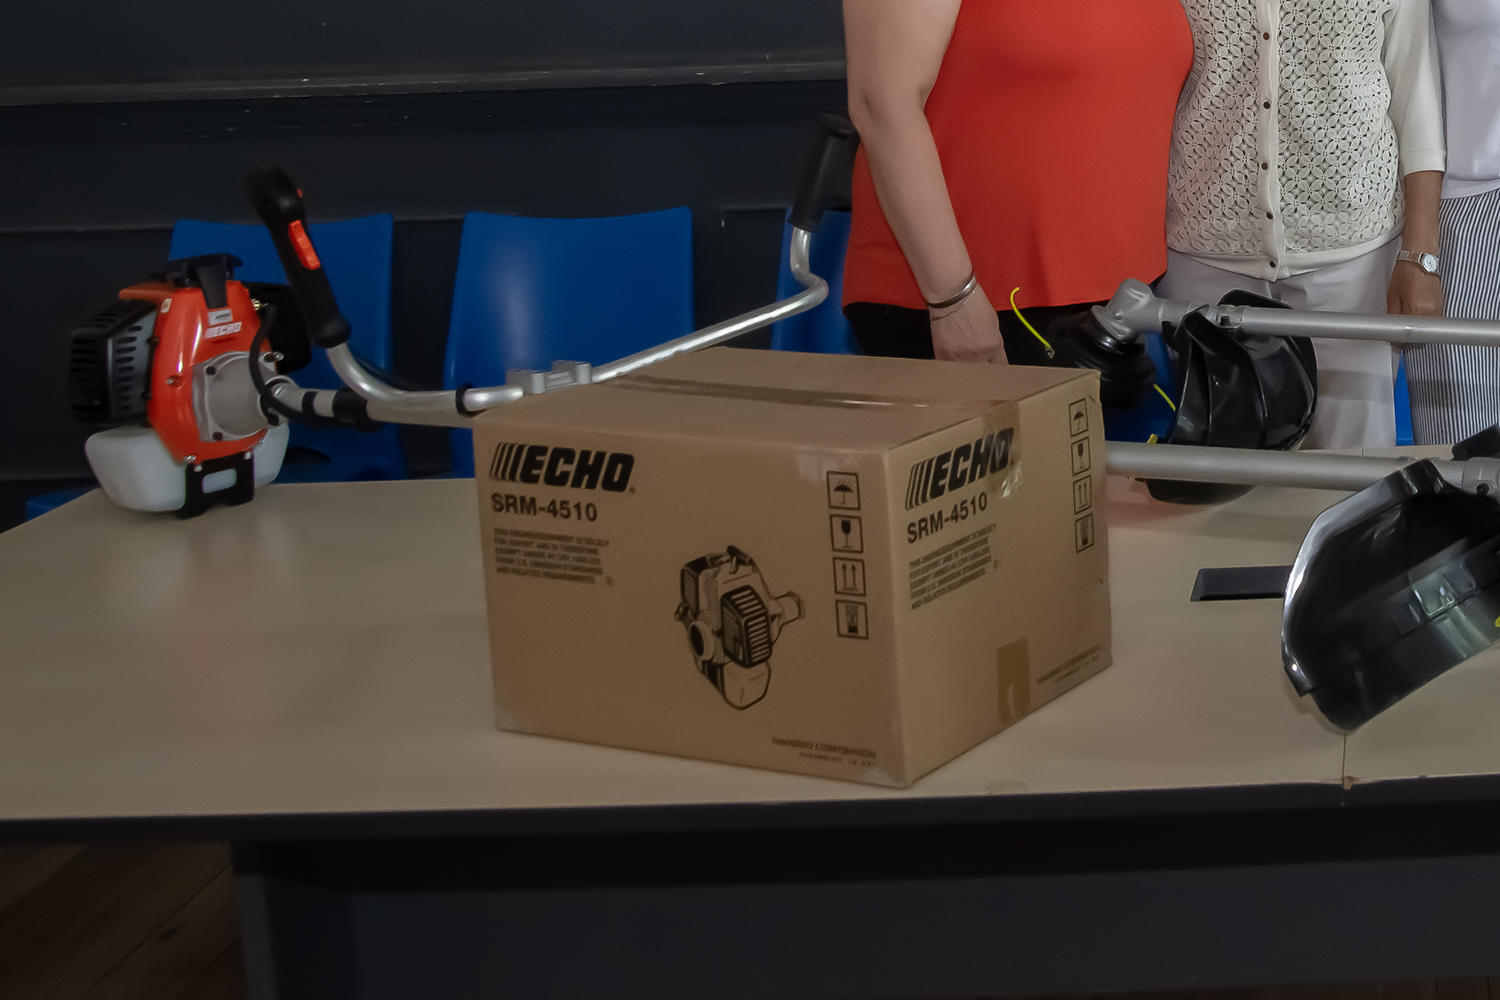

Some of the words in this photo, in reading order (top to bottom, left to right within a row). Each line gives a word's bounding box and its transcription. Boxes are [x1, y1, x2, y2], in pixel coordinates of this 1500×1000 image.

[519, 444, 635, 493] ECHO
[929, 427, 1014, 500] ECHO
[491, 492, 598, 522] SRM-4510
[906, 491, 988, 544] SRM-4510
